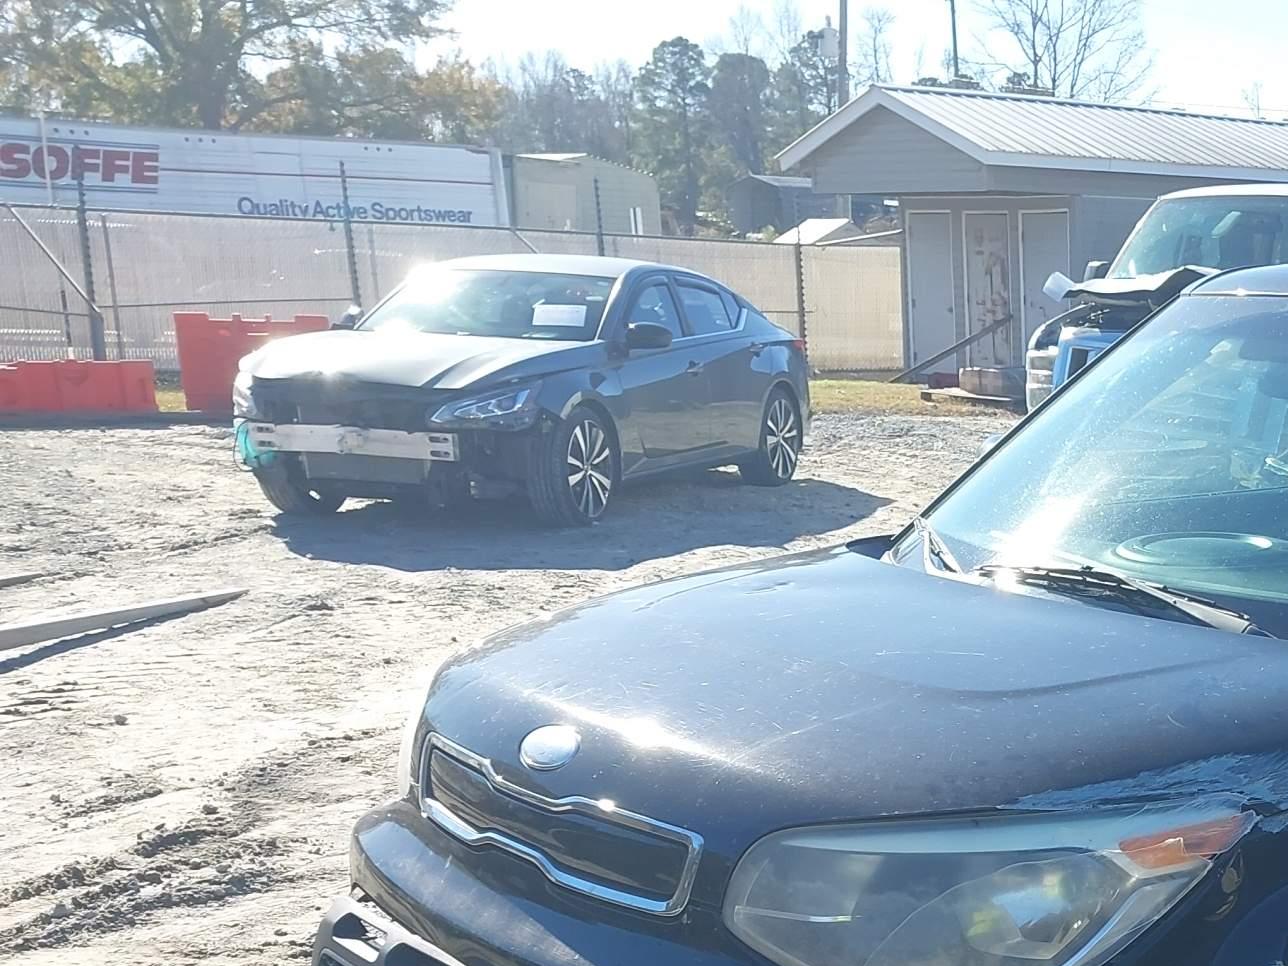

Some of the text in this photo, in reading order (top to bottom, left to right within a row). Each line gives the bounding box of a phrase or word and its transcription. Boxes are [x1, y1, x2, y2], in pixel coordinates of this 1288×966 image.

[0, 143, 159, 184] SOFFE
[237, 197, 308, 217] Quality
[371, 202, 473, 223] Sportswear
